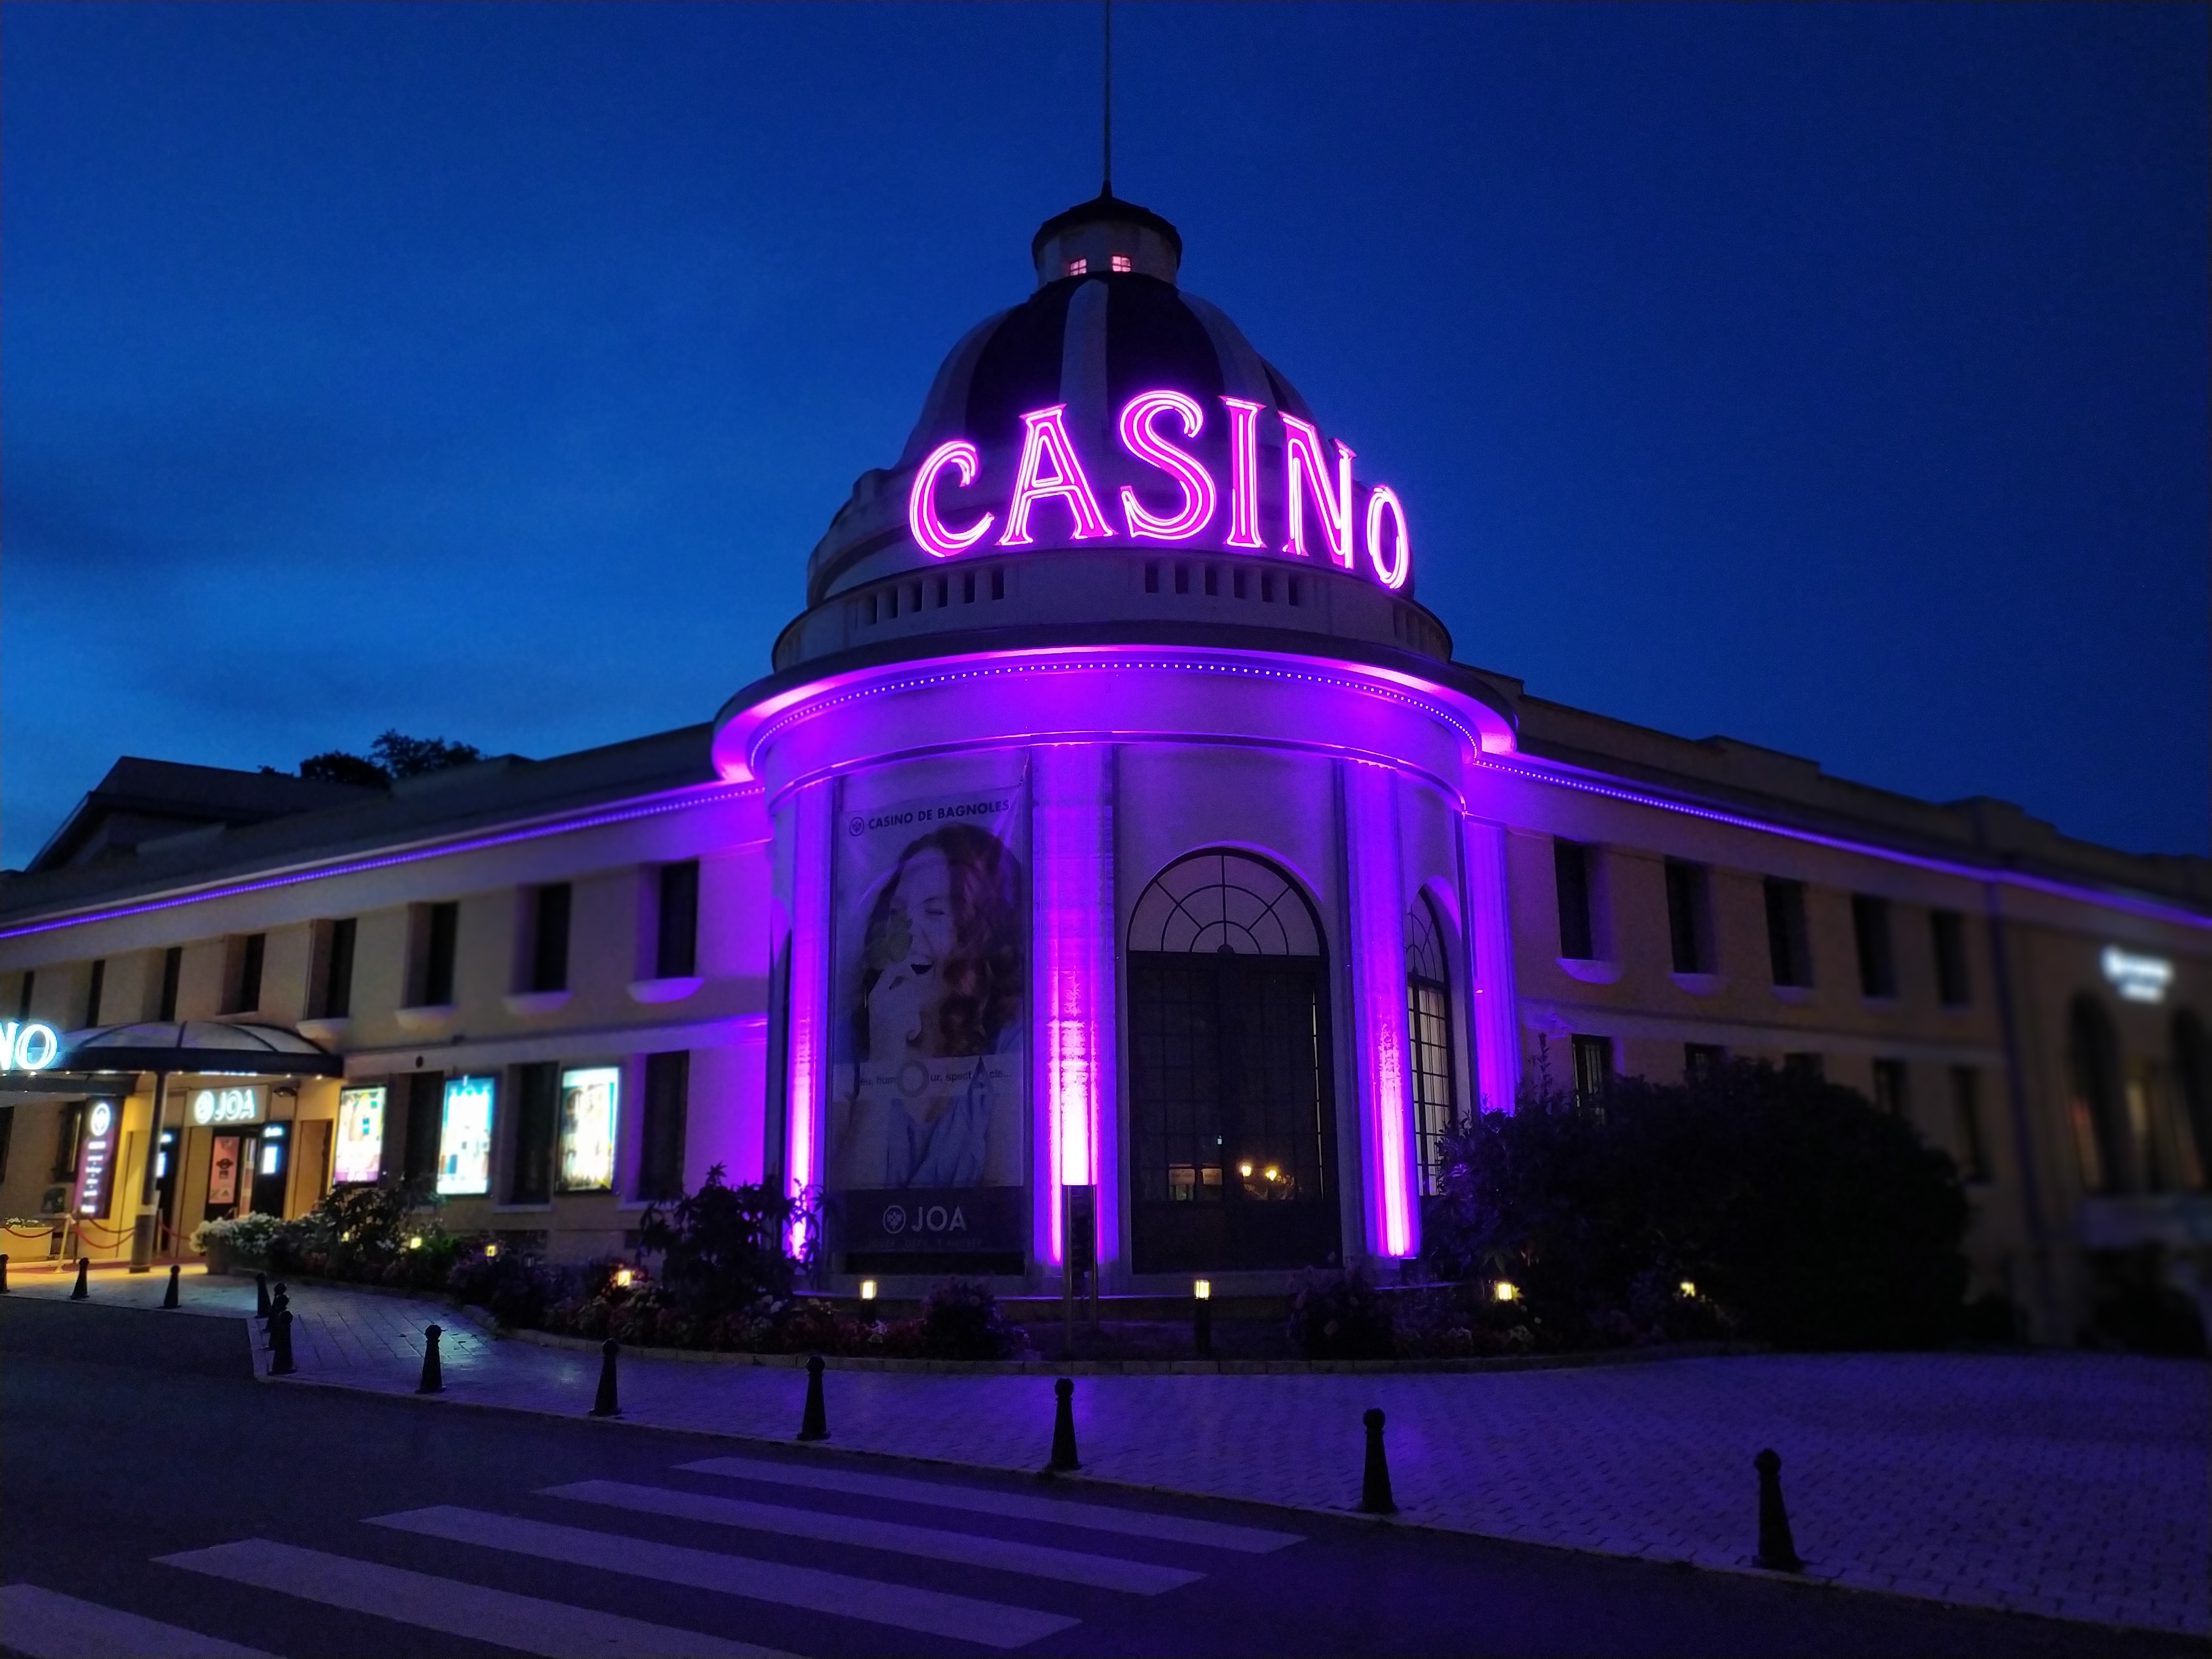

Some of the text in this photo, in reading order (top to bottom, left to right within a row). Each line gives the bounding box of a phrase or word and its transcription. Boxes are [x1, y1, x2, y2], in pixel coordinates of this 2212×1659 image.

[909, 389, 1410, 589] CASINO
[868, 800, 1010, 830] CASINO DE BAGNOLES
[214, 1089, 255, 1121] JOA
[911, 1205, 967, 1232] JOA
